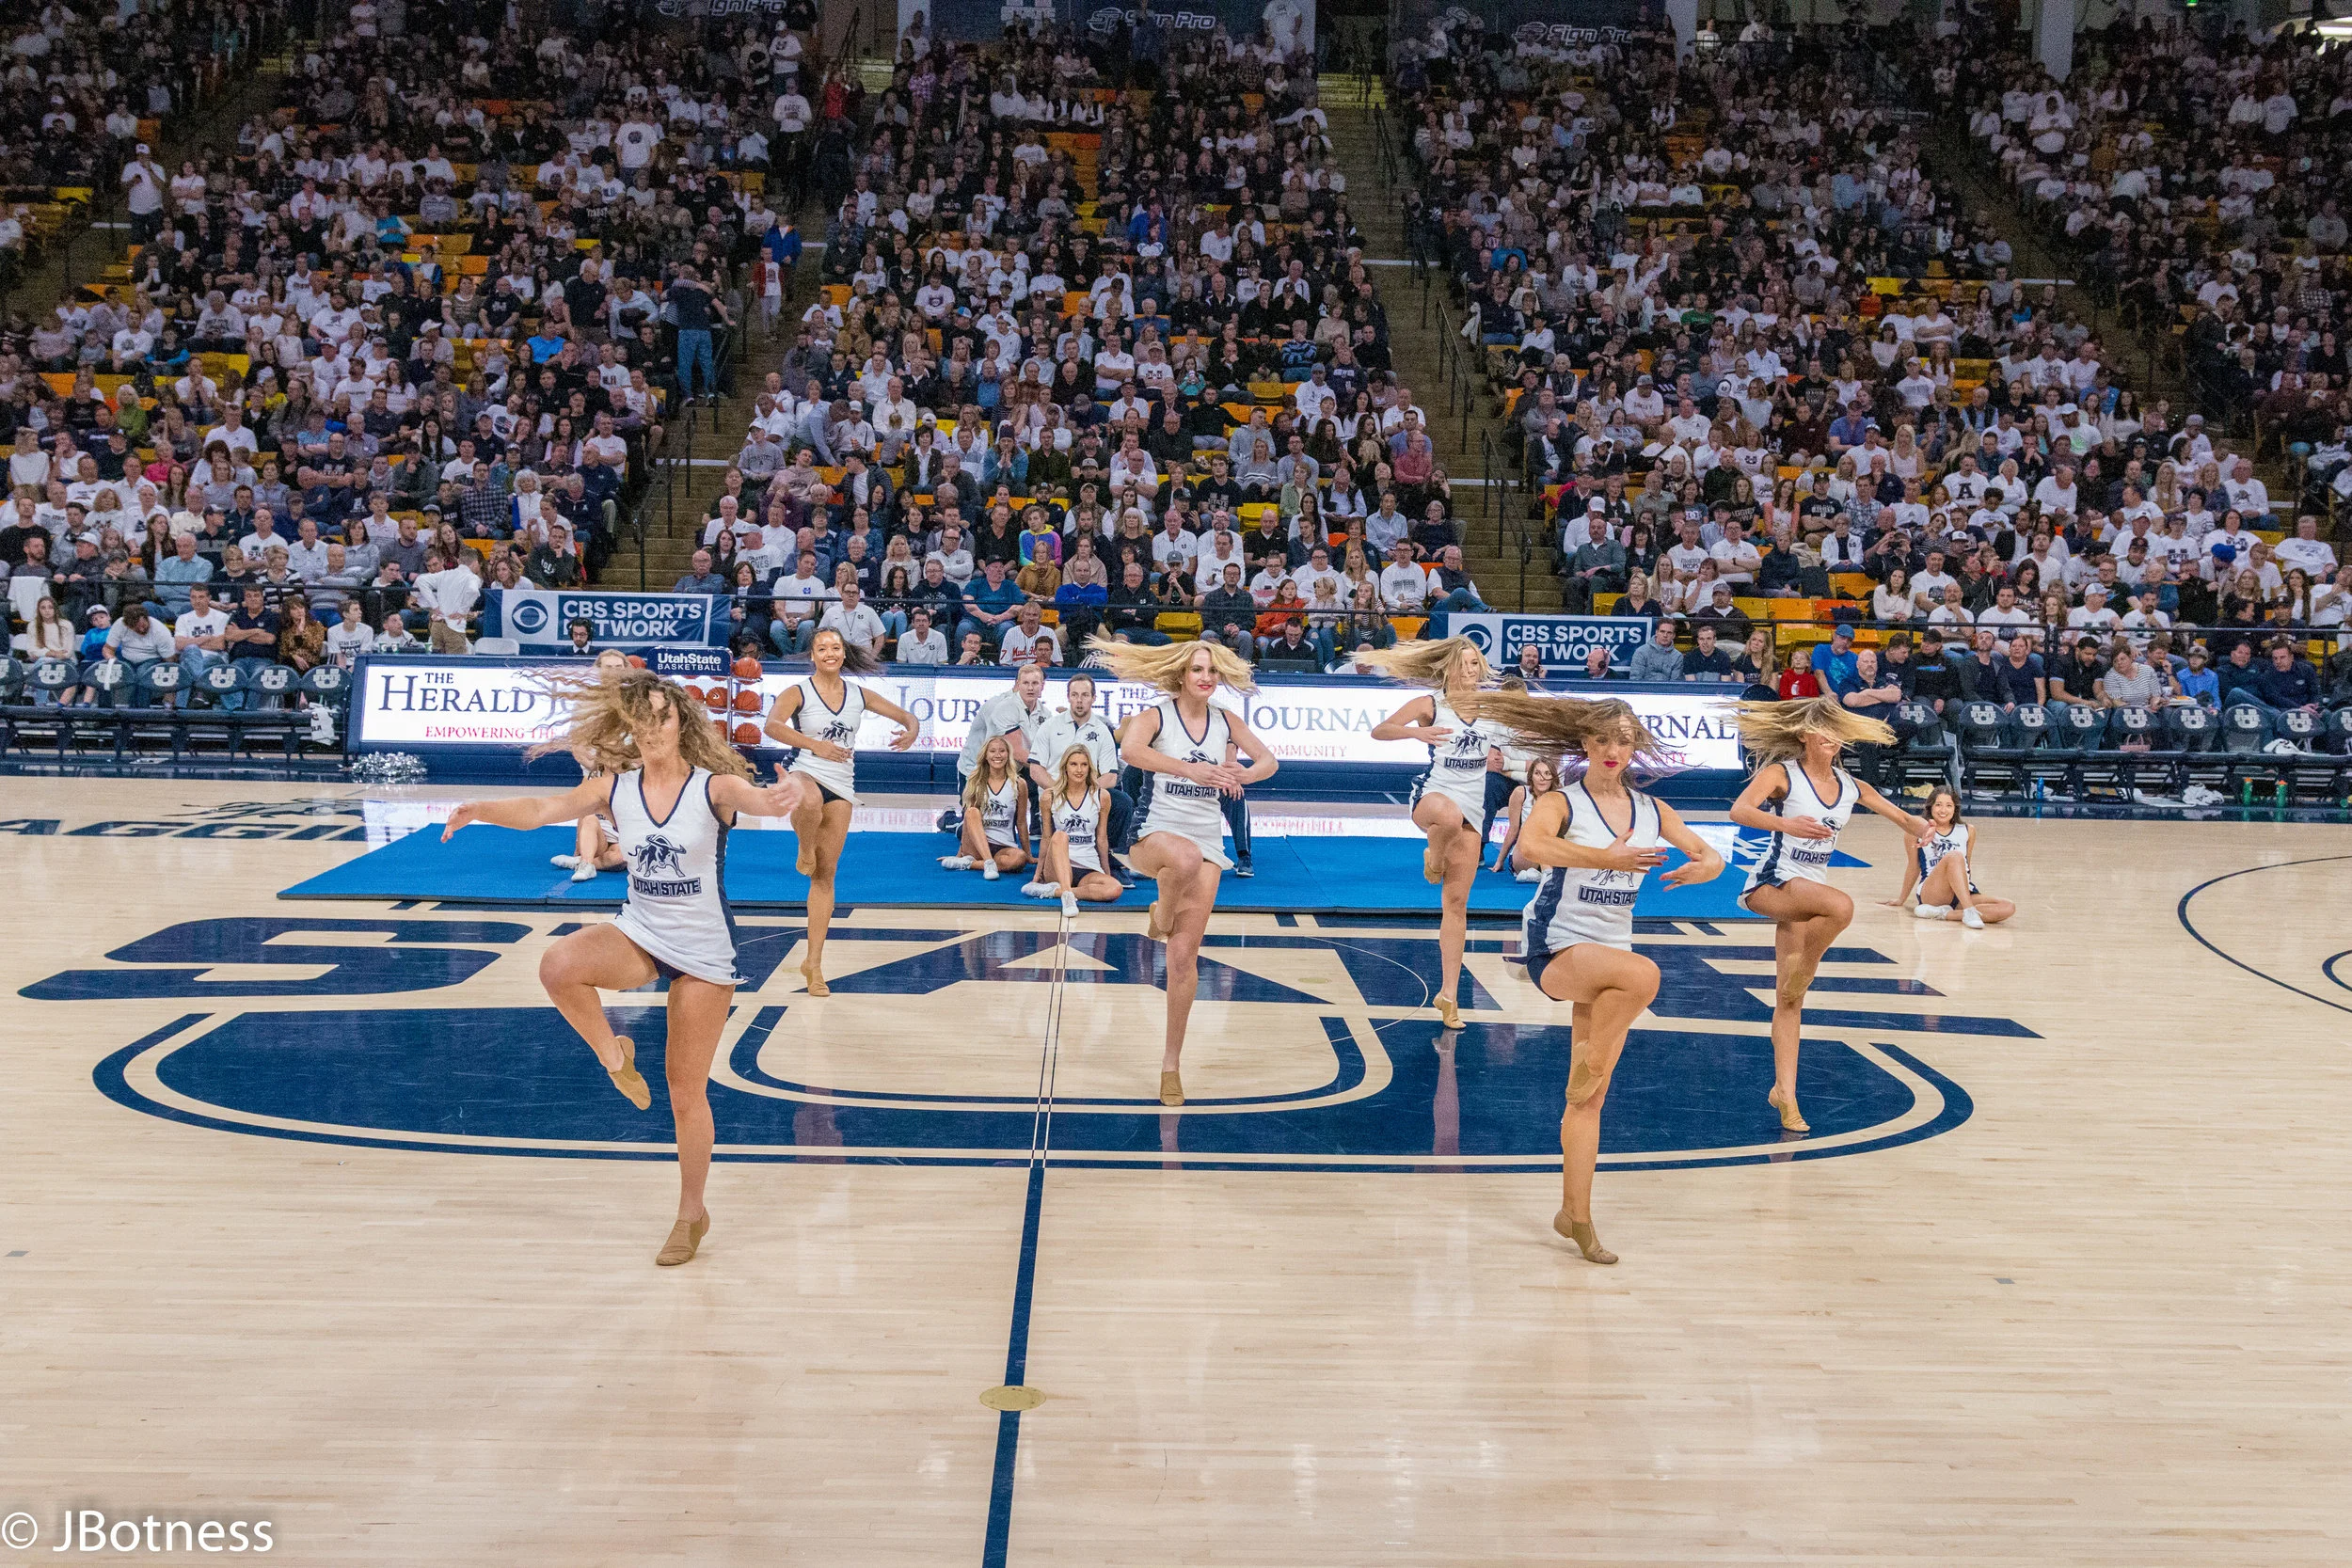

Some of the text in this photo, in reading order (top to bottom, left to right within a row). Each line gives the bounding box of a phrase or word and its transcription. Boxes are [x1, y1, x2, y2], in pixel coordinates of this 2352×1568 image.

[1956, 483, 1976, 499] A
[563, 600, 702, 620] CBS SPORTS
[1506, 625, 1642, 643] CBS SPORTS
[657, 653, 721, 664] UtahState
[1001, 649, 1007, 659] 7
[657, 663, 722, 672] BASKETBALL
[425, 673, 453, 684] THE
[378, 675, 534, 712] HERALD
[1120, 688, 1149, 700] THE
[425, 726, 524, 739] EMPOWERING
[1445, 757, 1468, 768] UTAH
[1167, 783, 1192, 797] UTAH
[1790, 847, 1819, 863] UTAH
[633, 876, 700, 897] UTAH STATE
[1580, 887, 1612, 905] UTAH
